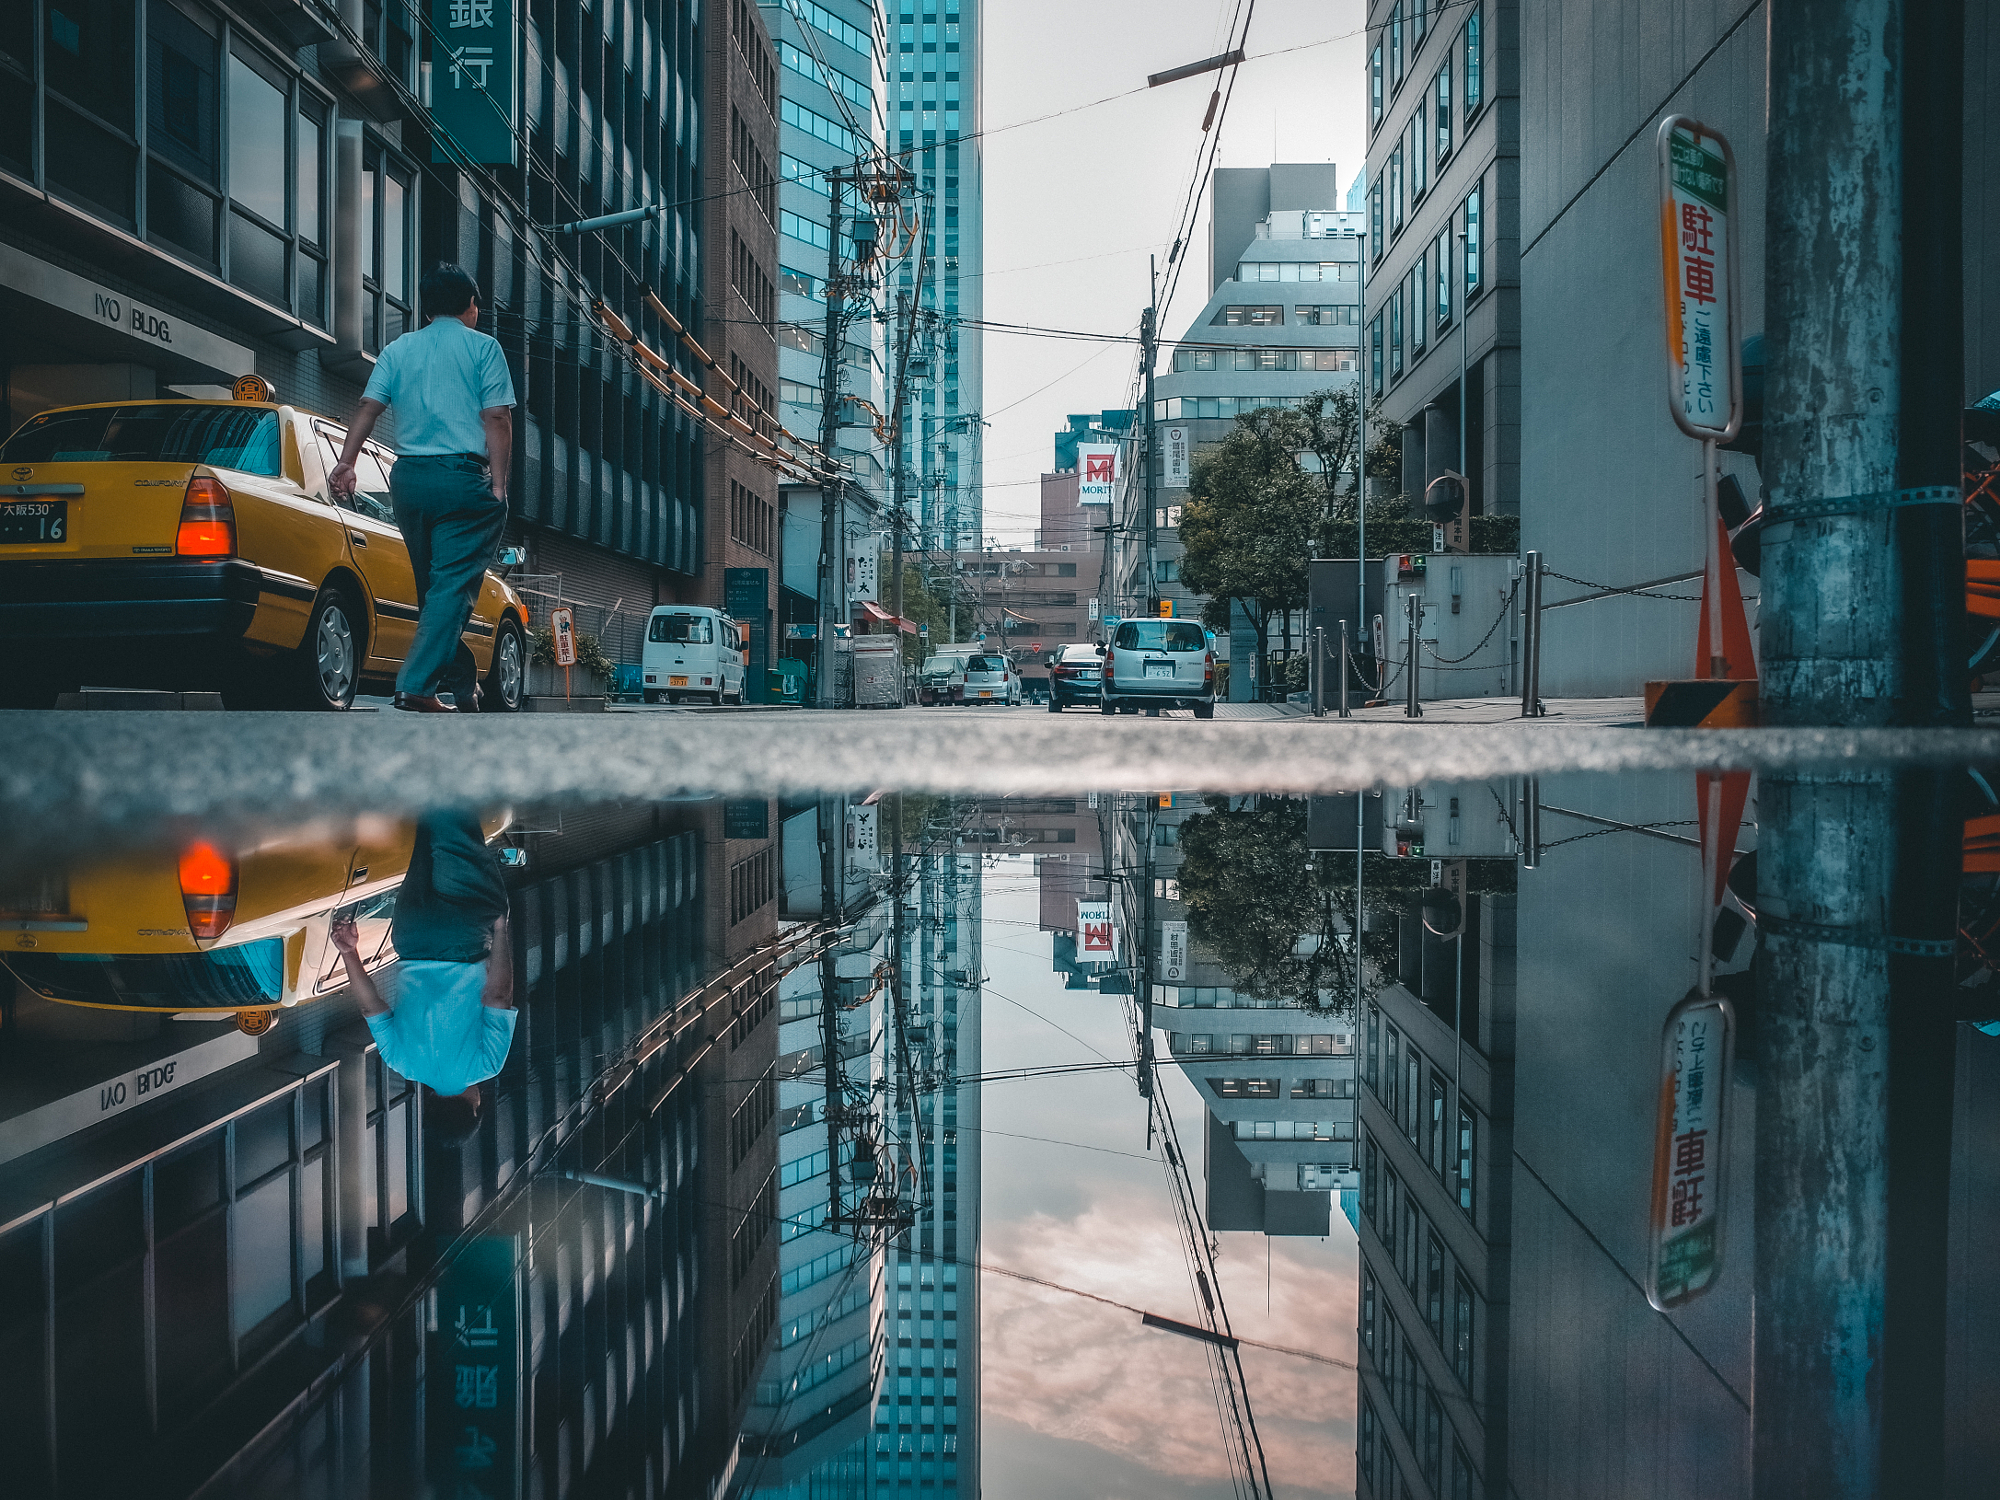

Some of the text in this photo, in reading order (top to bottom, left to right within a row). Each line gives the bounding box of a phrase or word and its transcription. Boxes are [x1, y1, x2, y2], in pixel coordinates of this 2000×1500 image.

[1682, 203, 1717, 306] 駐車
[95, 293, 172, 343] IYO BLDG.
[1695, 310, 1714, 414] ご遠慮下さい
[1435, 531, 1442, 550] 注意
[857, 556, 870, 594] たこ太
